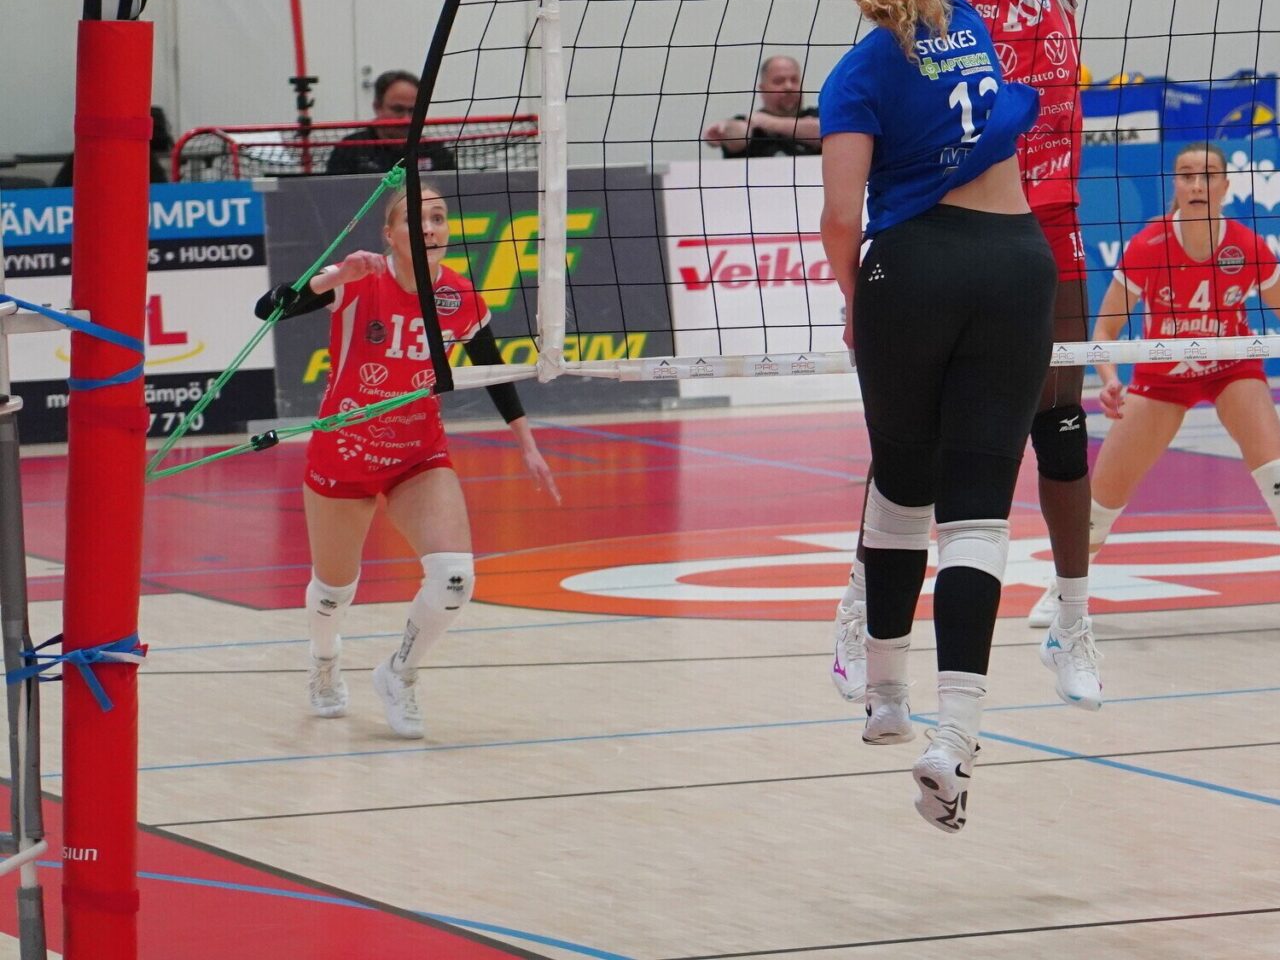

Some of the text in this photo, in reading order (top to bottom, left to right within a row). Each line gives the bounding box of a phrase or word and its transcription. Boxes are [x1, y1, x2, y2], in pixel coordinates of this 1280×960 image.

[916, 29, 977, 56] STOKES
[1056, 68, 1070, 81] Oy
[179, 243, 254, 263] HUOLTO
[1187, 279, 1212, 312] 4
[384, 313, 431, 361] 13
